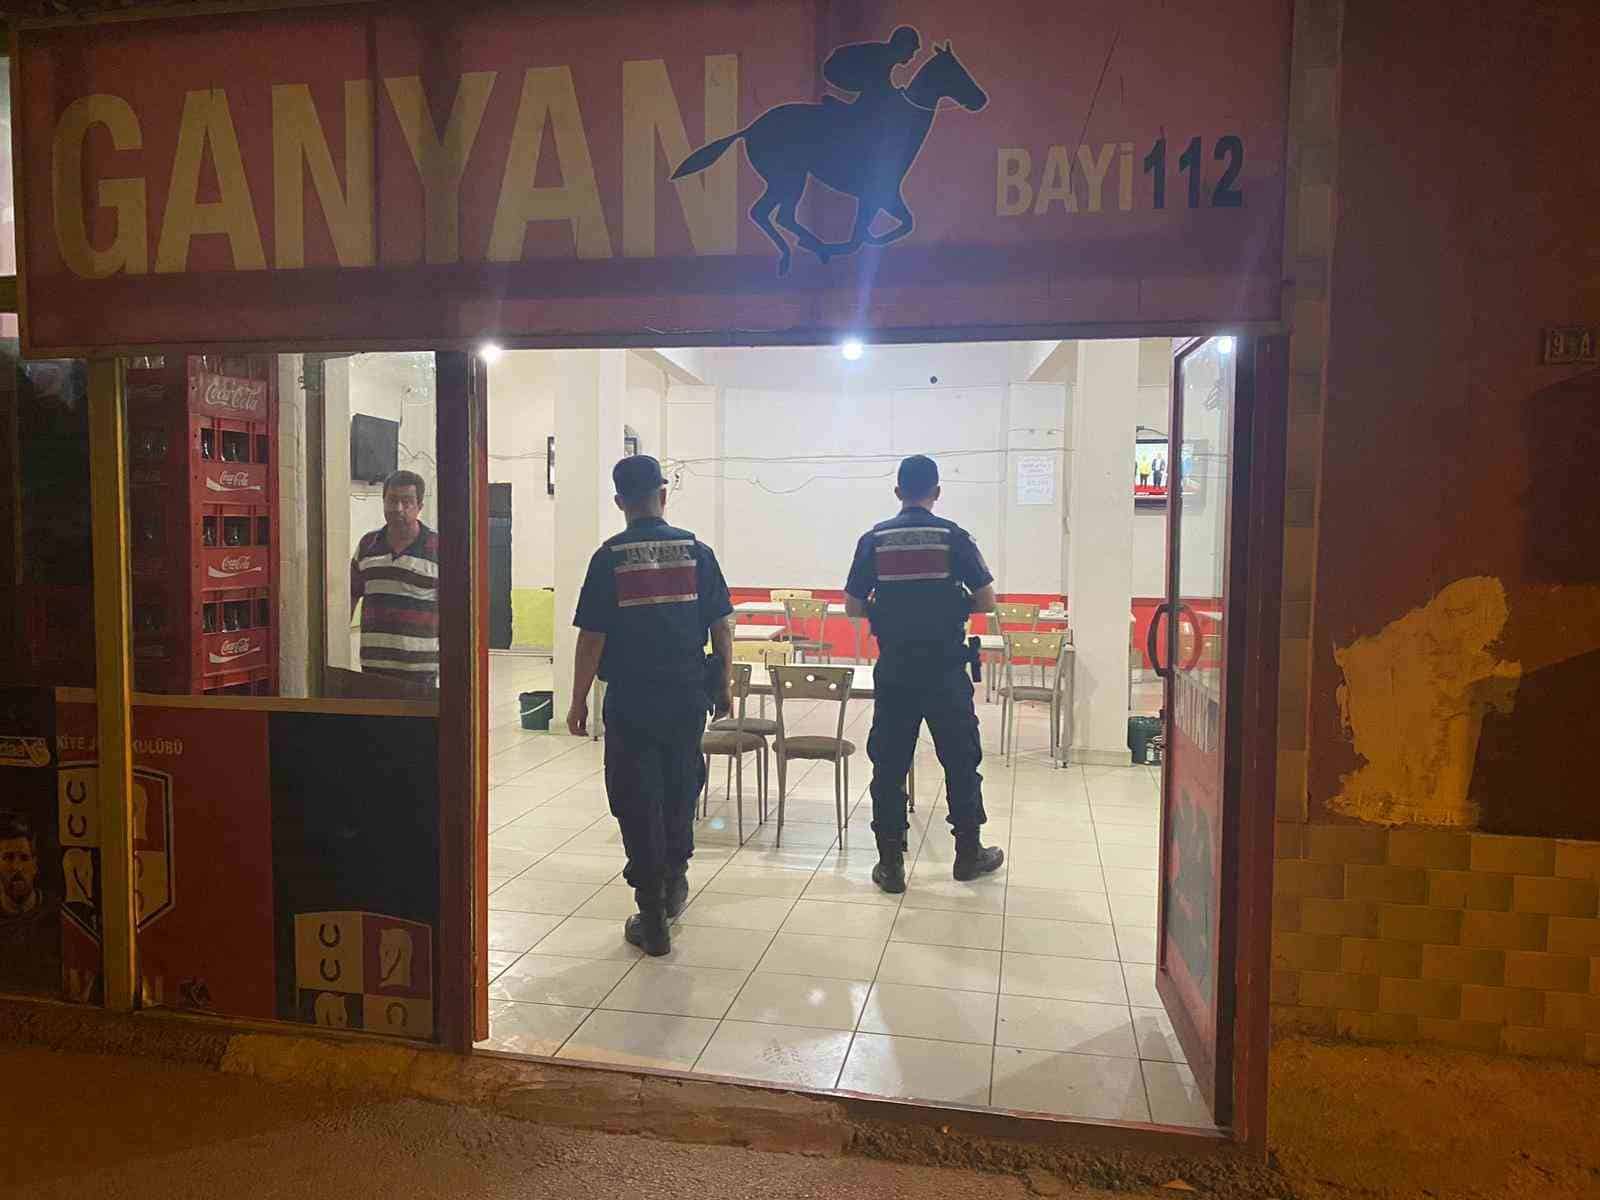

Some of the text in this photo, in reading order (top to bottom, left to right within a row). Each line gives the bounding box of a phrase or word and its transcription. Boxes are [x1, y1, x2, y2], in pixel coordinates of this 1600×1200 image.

[52, 54, 740, 280] GANYAN
[1144, 134, 1245, 209] 112
[56, 732, 86, 753] KİYE
